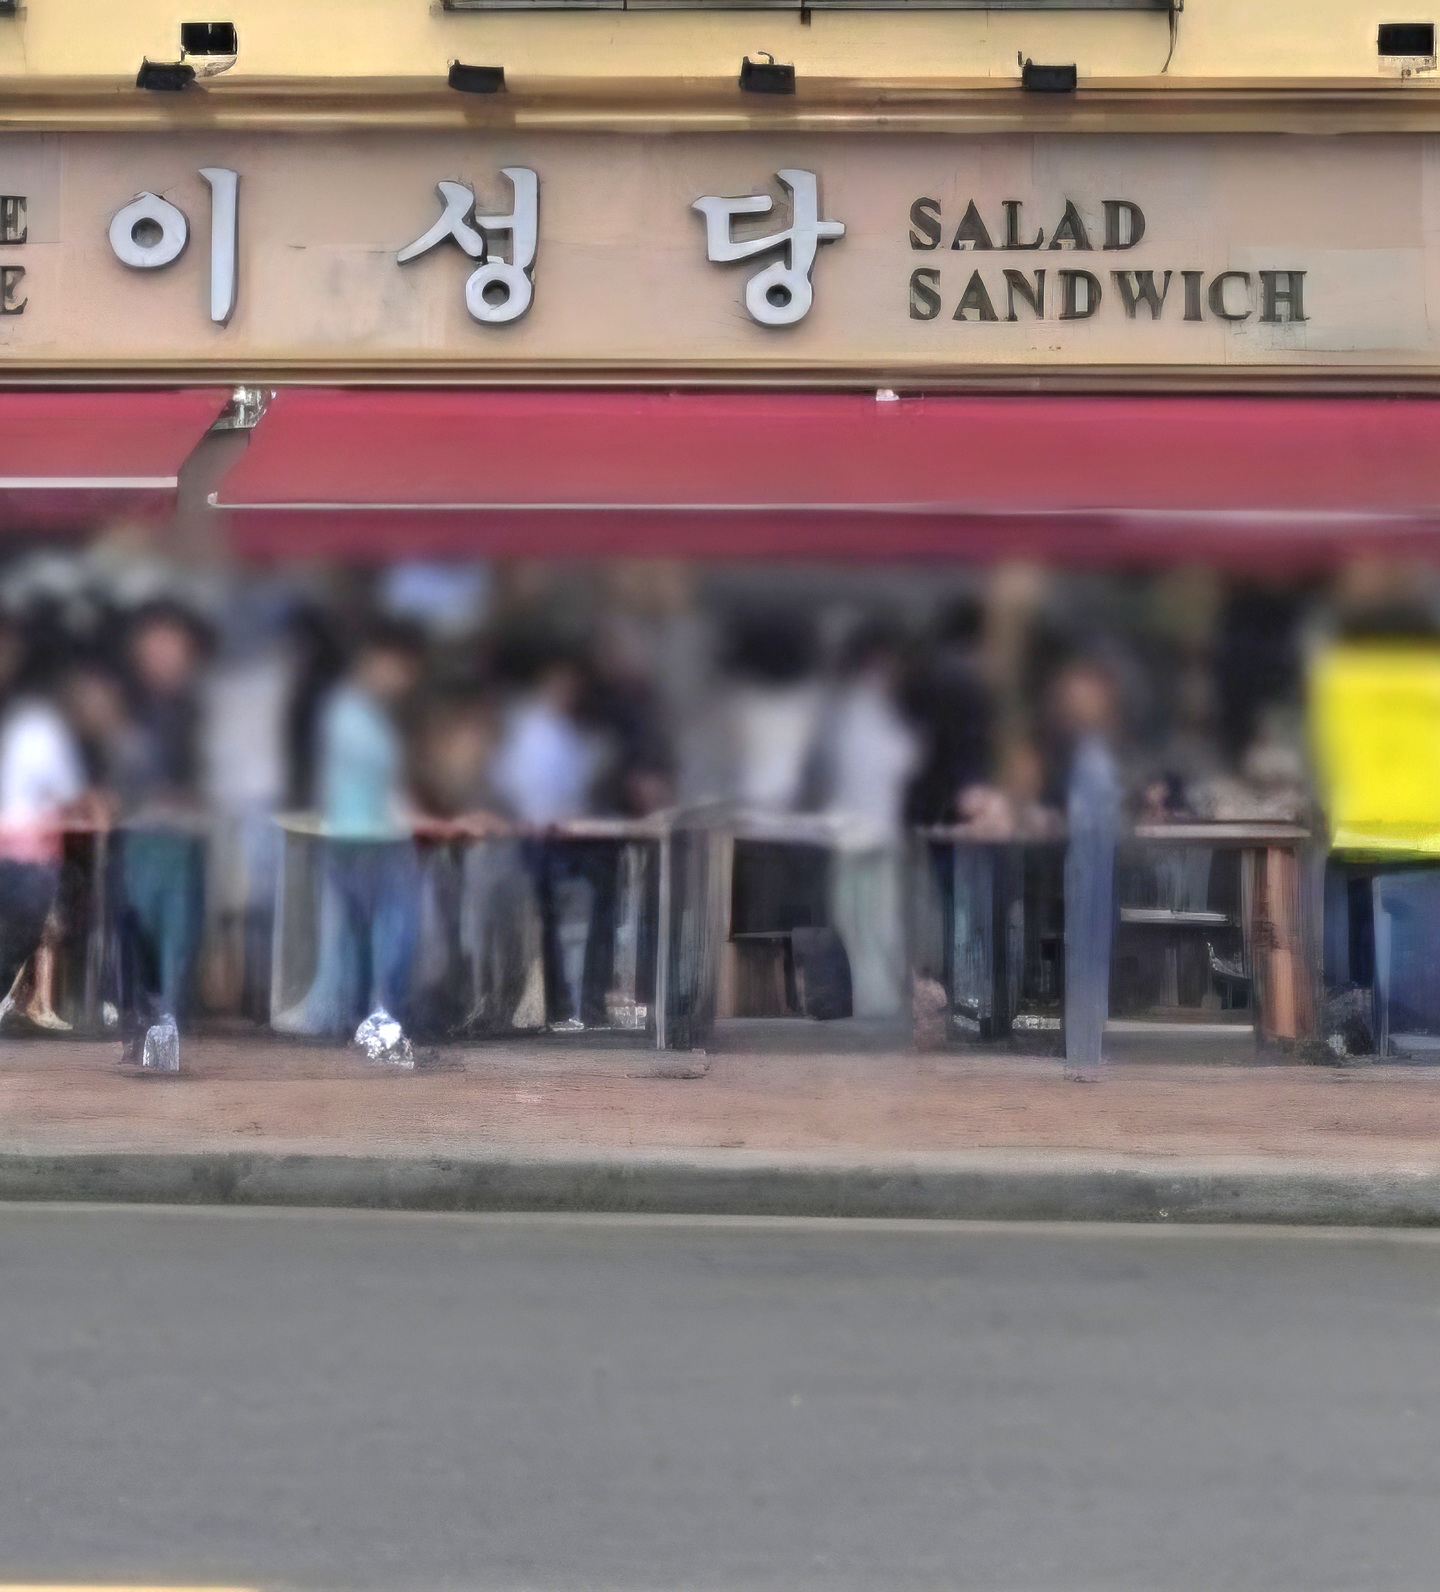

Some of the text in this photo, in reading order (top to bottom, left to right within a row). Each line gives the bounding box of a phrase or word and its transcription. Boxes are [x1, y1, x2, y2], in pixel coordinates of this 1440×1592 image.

[108, 166, 847, 328] 이성당
[908, 196, 1147, 251] SALAD
[908, 267, 1310, 322] SANDWICH
